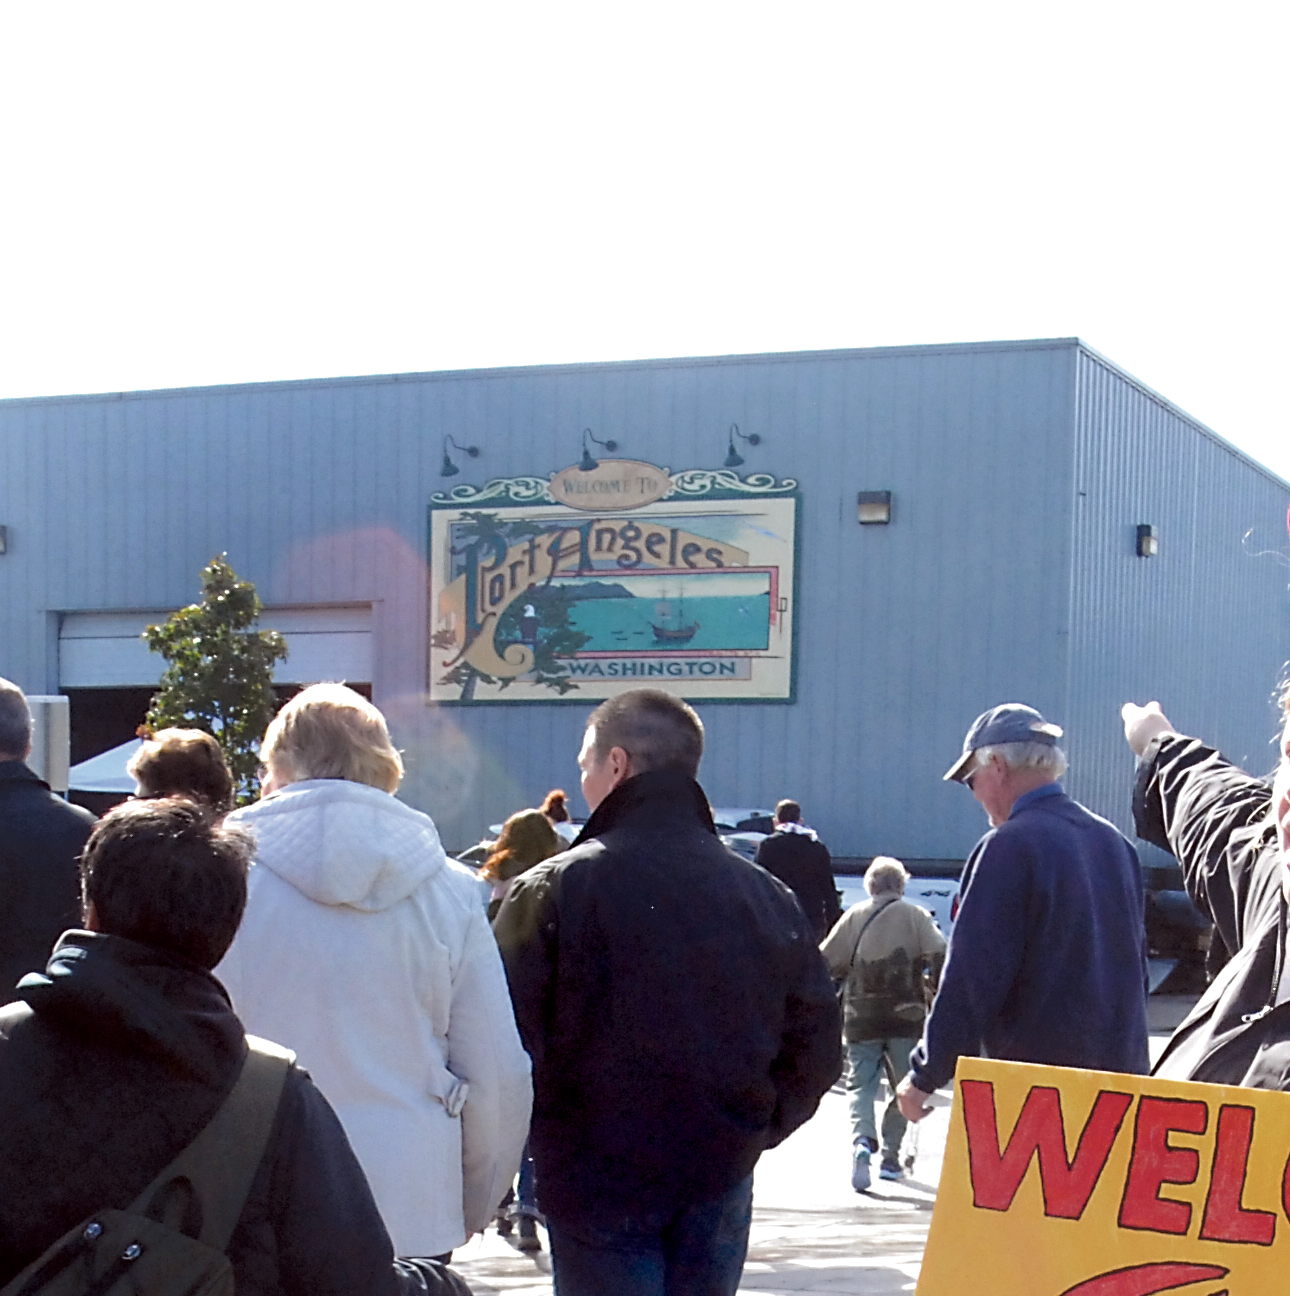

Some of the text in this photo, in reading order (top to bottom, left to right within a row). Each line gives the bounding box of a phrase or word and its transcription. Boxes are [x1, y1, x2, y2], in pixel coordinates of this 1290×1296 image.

[562, 477, 658, 494] WELCOME TO
[446, 518, 725, 657] Port Angeles
[567, 661, 737, 677] WASHINGTON
